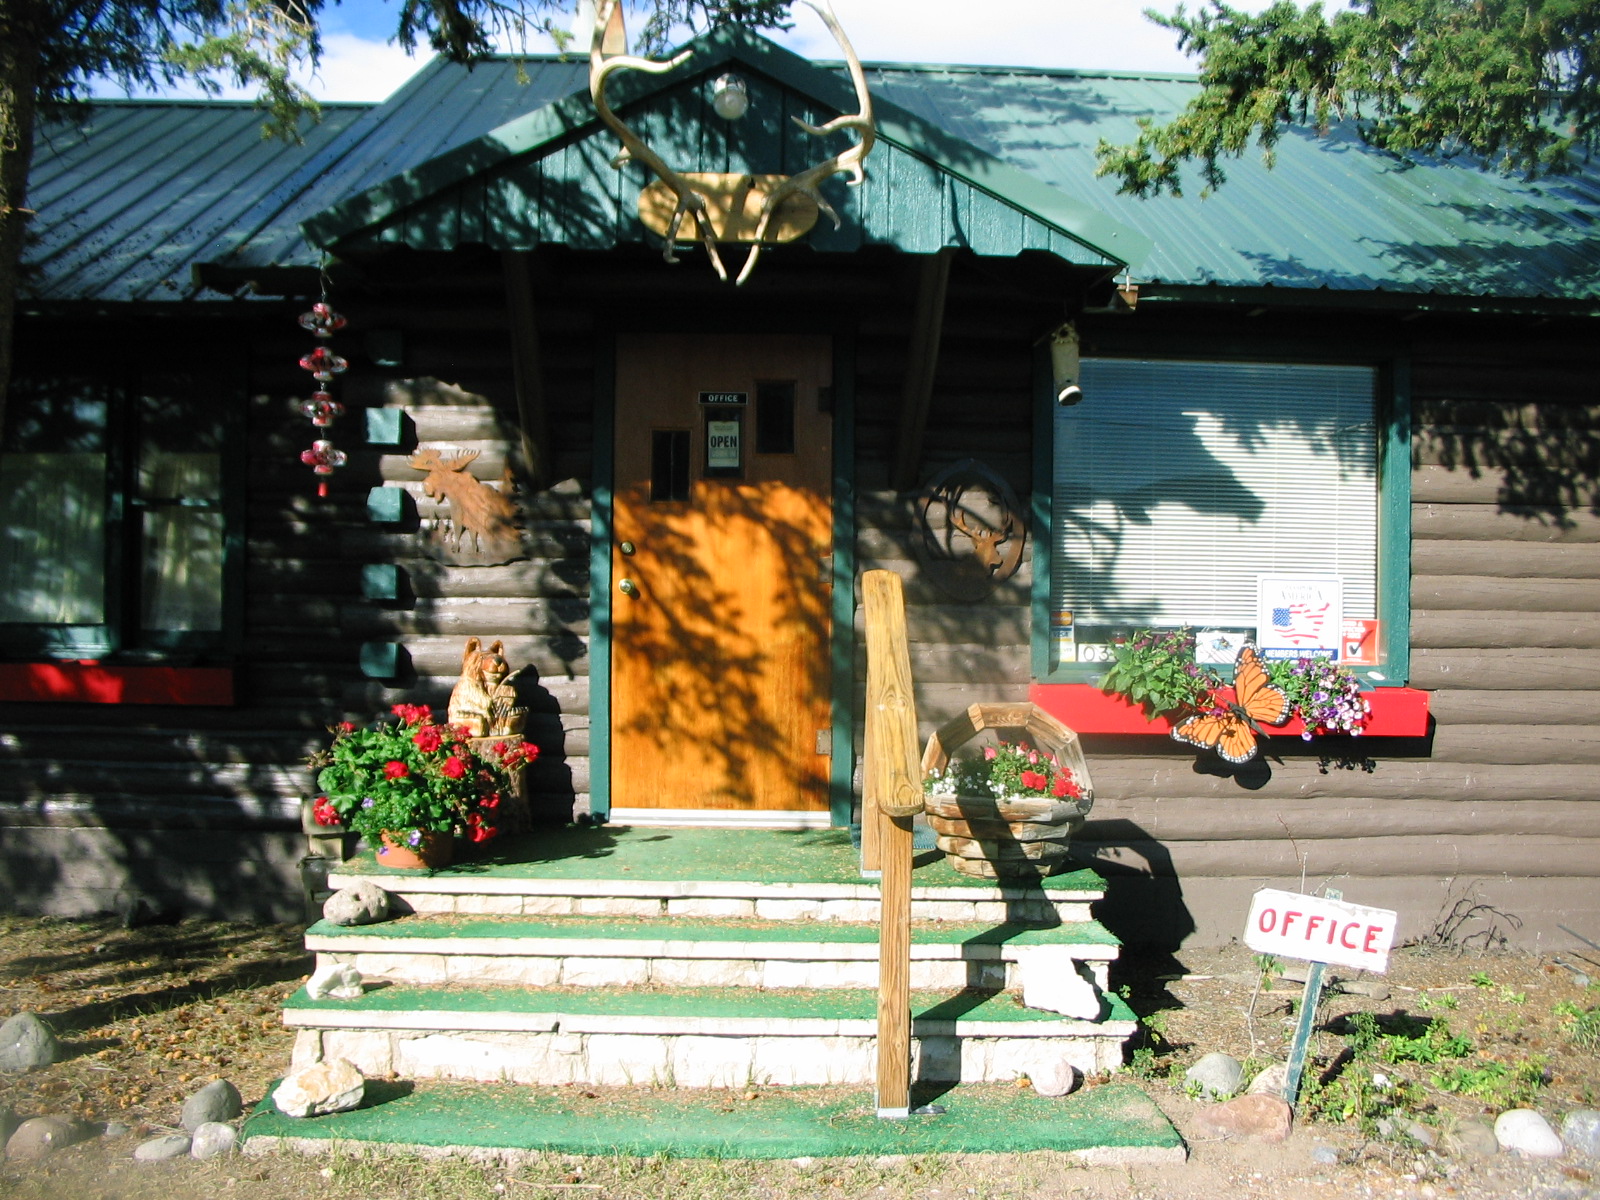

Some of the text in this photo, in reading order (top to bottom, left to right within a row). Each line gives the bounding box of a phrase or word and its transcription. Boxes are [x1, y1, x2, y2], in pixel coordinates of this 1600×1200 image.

[708, 394, 738, 402] OFFICE
[710, 435, 737, 448] OPEN
[1264, 649, 1298, 658] MEMBERS
[1258, 908, 1383, 953] OFFICE
